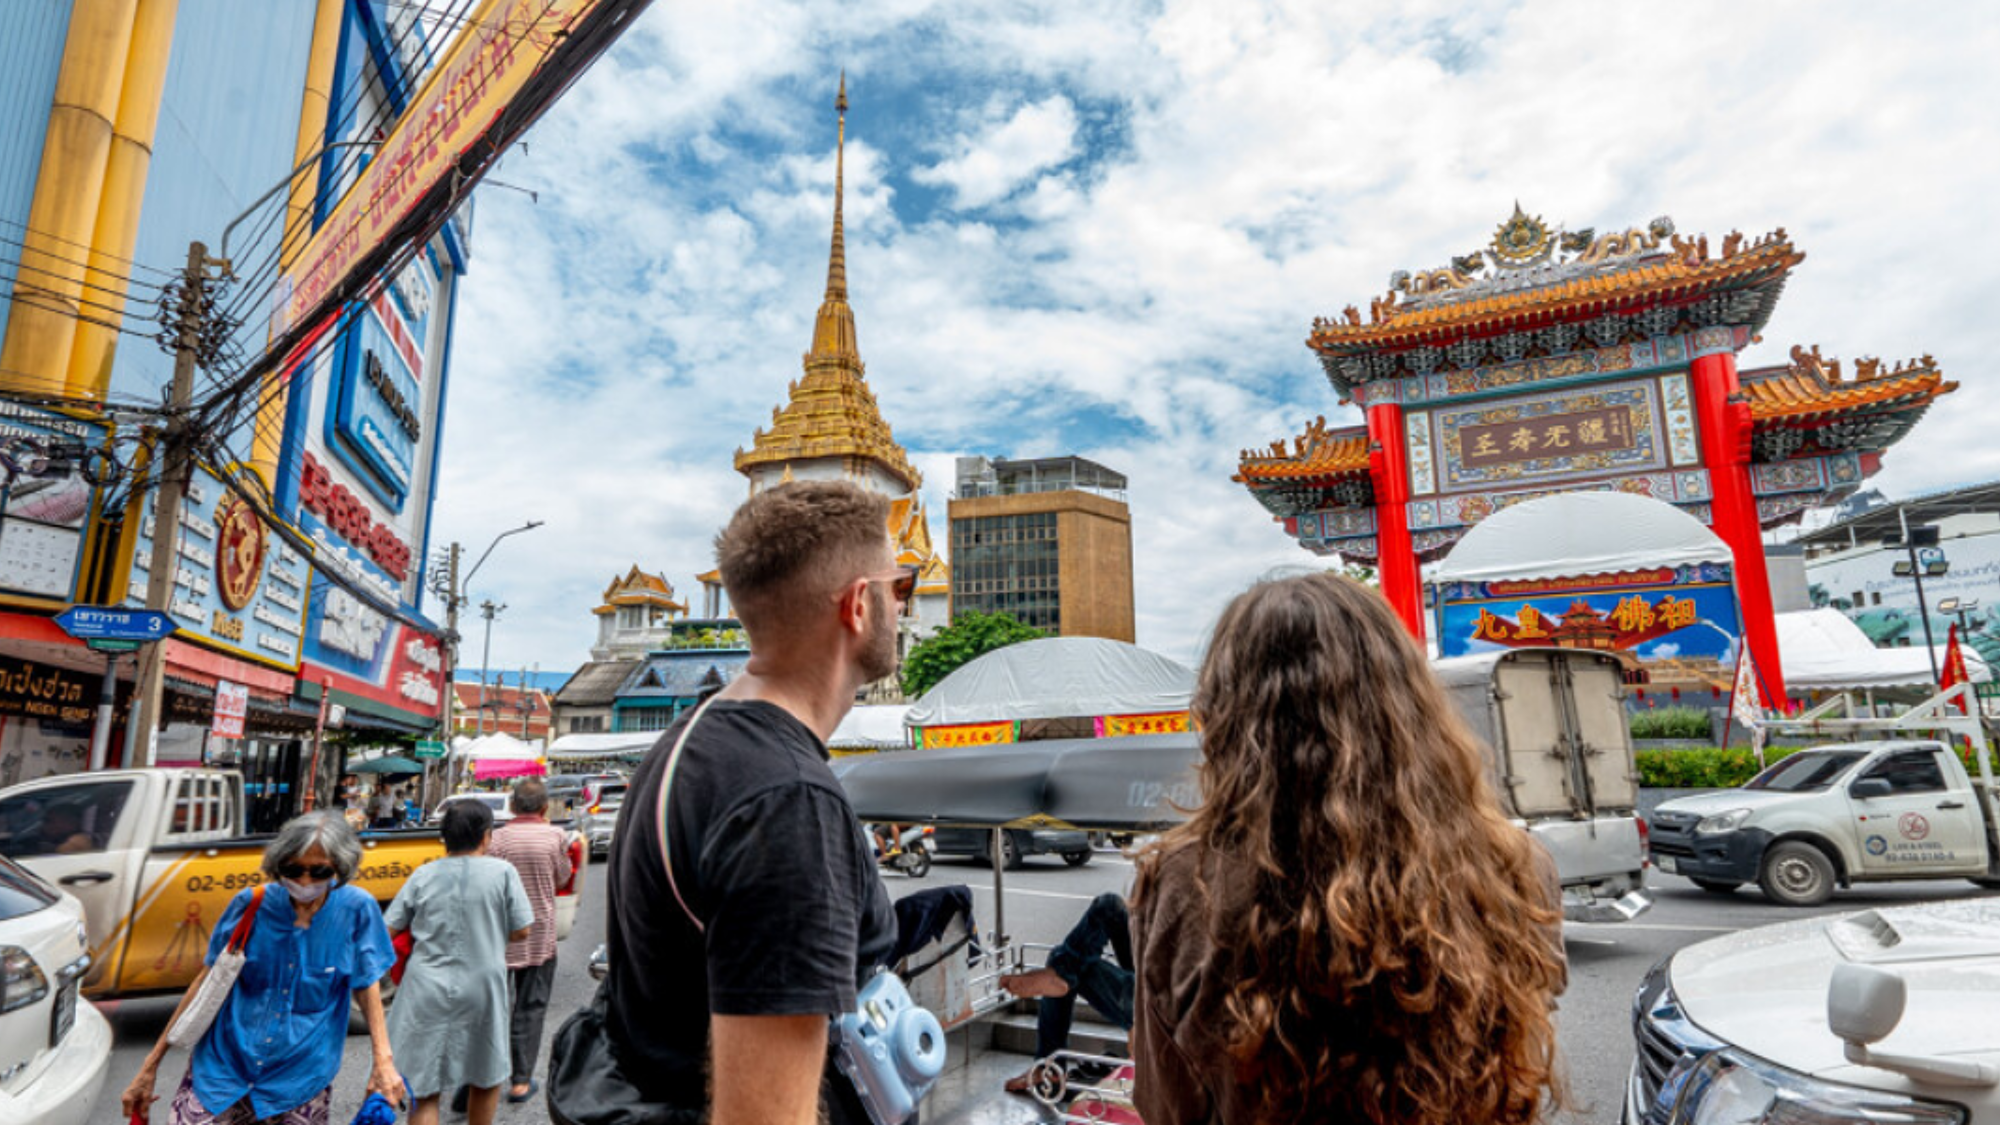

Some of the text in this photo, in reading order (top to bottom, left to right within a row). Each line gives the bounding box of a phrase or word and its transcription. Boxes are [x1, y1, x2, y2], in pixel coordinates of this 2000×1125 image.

[148, 616, 163, 631] 3
[1471, 595, 1697, 639] 九皇 佛祖
